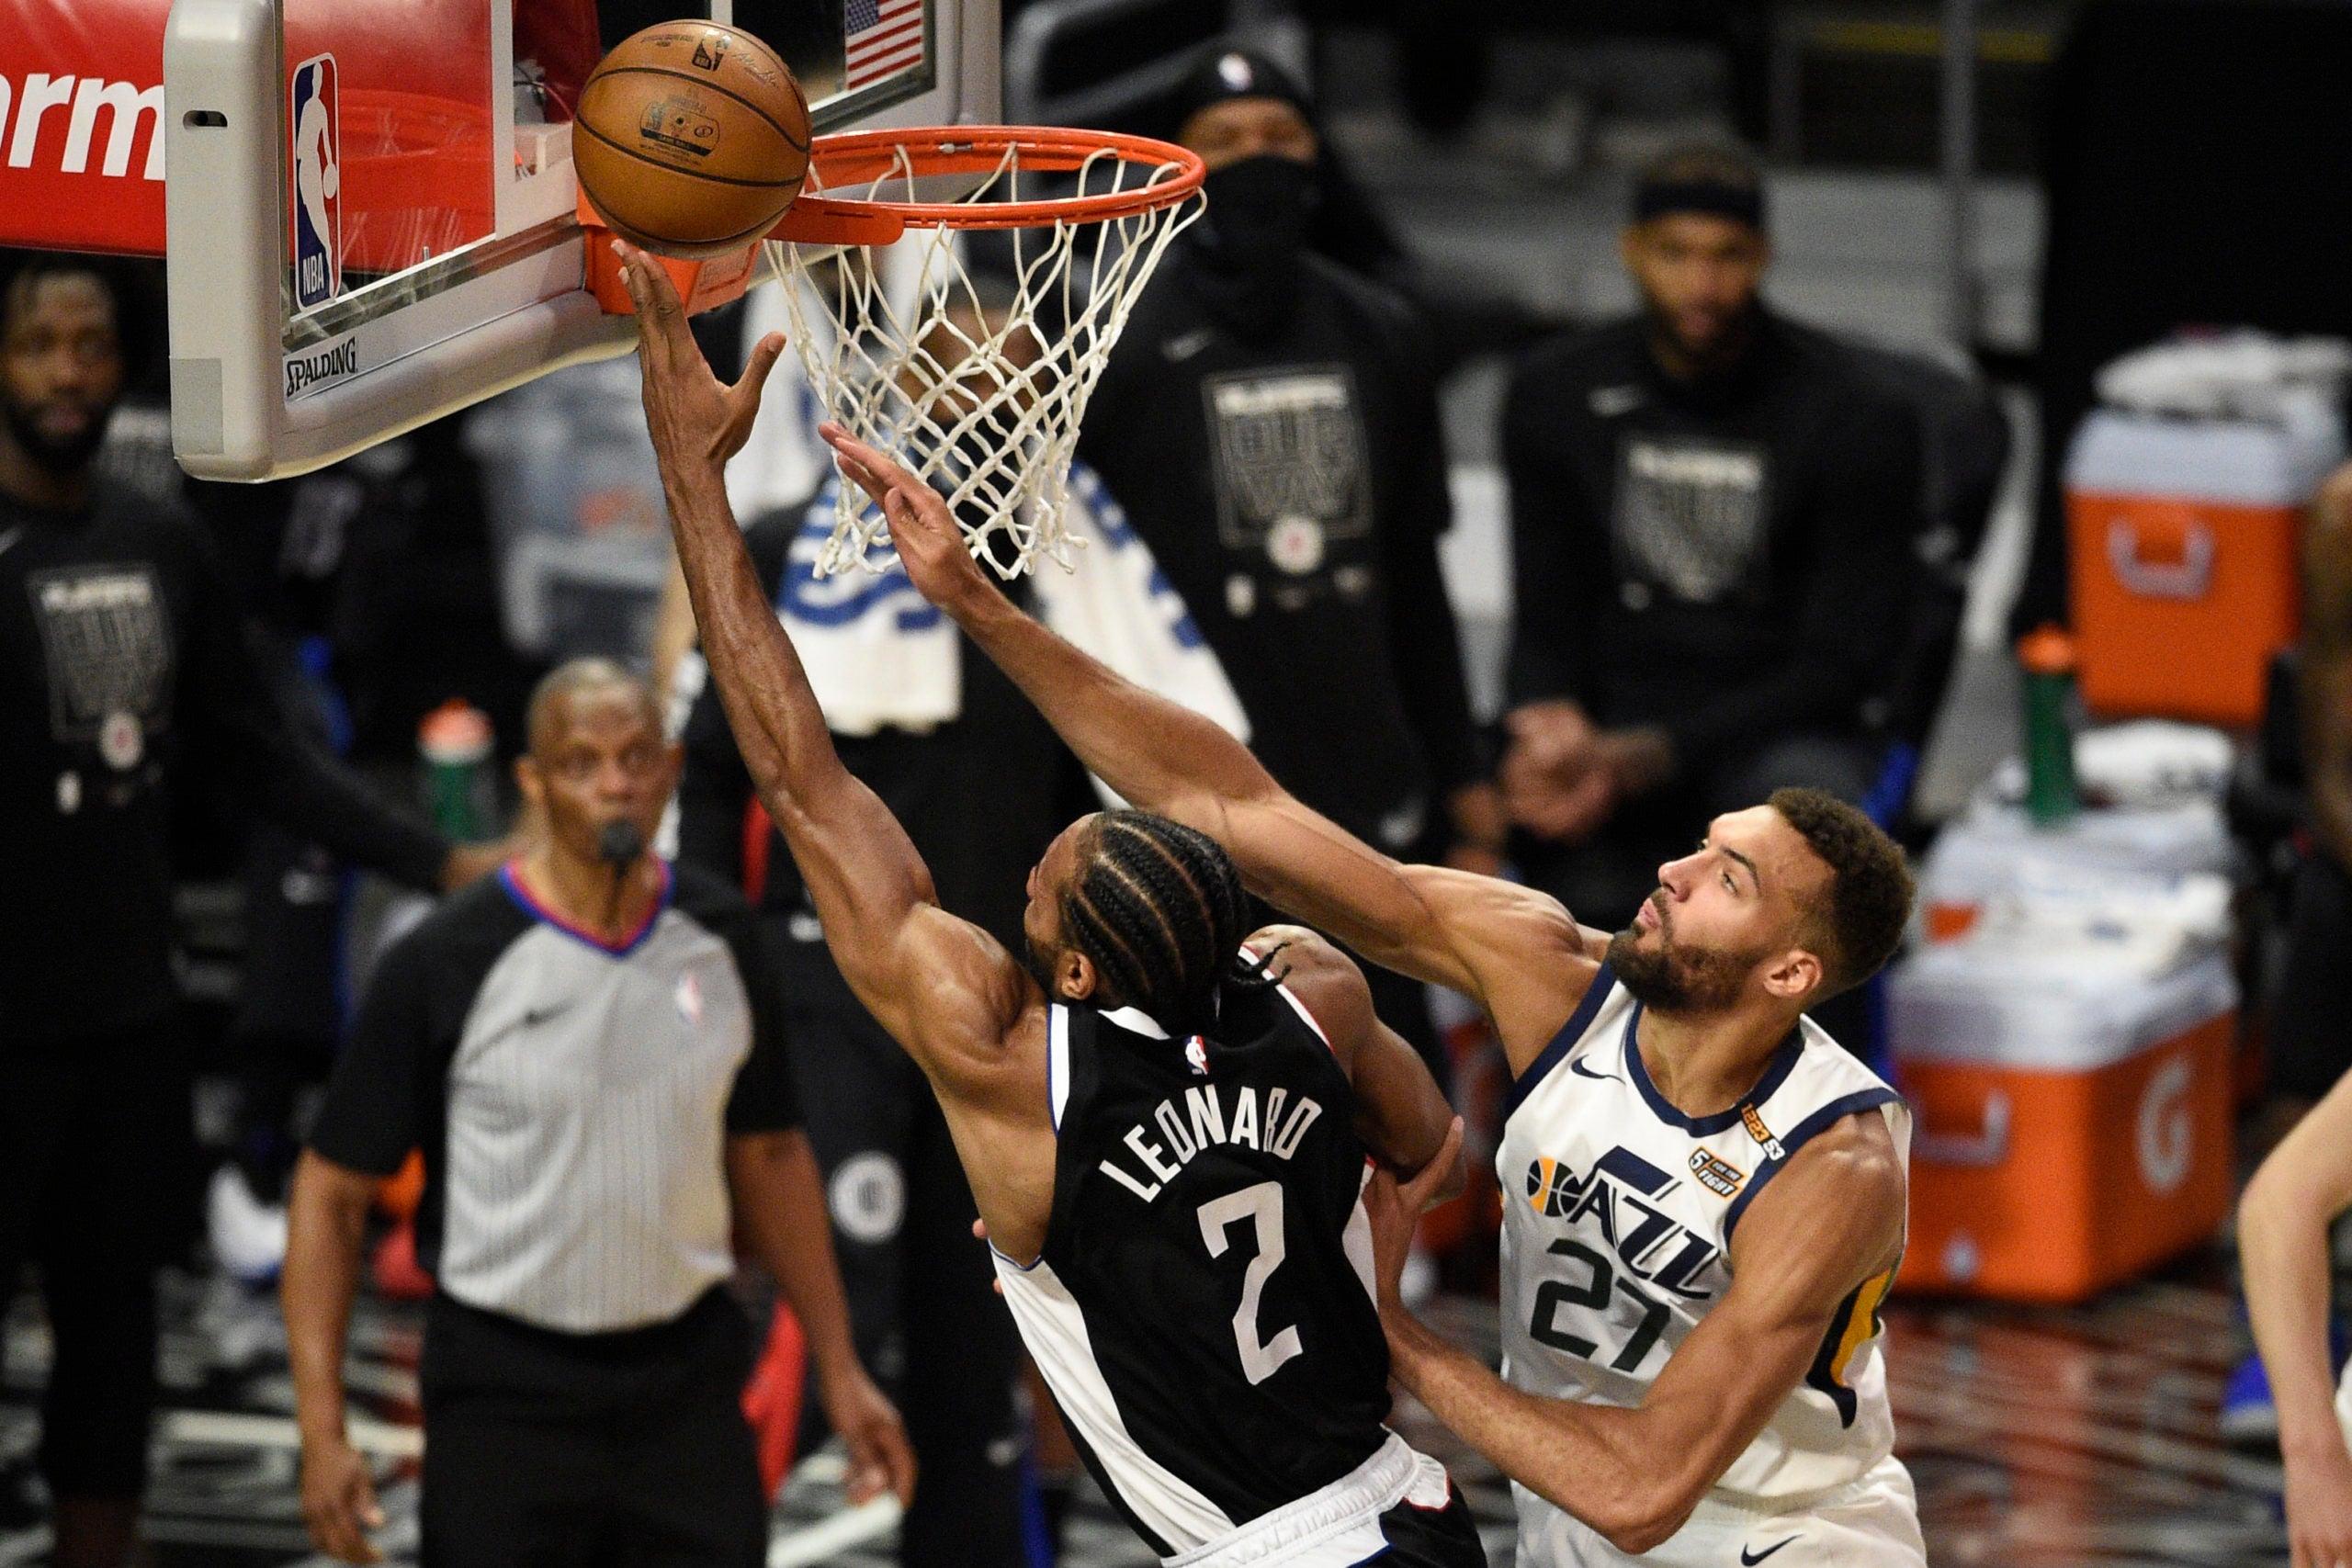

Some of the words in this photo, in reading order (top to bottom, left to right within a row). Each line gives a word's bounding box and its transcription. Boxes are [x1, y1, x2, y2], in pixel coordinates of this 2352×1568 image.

[302, 252, 325, 296] NBA
[286, 336, 356, 398] SPALDING
[1099, 1084, 1323, 1203] LEONARD
[1690, 1150, 1711, 1170] 5
[1741, 1103, 1771, 1143] 1223
[1763, 1139, 1786, 1161] 53
[1698, 1169, 1736, 1196] FIGHT
[1196, 1180, 1304, 1385] 2
[1530, 1238, 1671, 1373] 27
